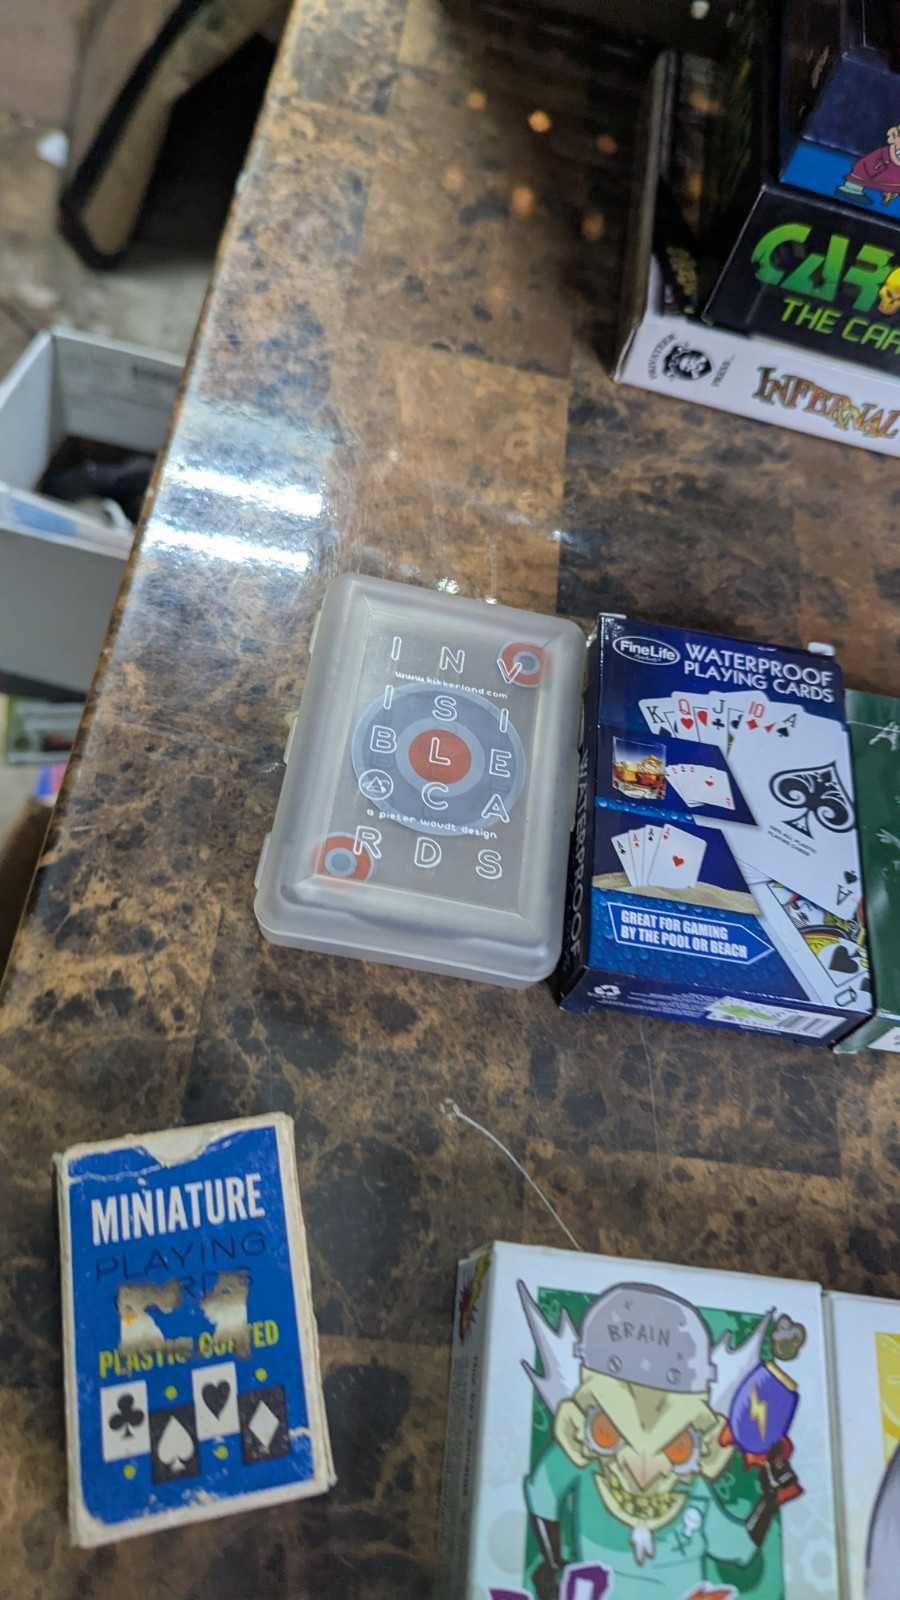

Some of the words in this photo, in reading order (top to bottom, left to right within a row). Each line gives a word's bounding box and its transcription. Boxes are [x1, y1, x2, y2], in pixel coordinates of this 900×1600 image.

[782, 297, 842, 334] THE
[648, 333, 677, 380] PRIVATEER
[620, 640, 676, 661] FineLife
[685, 642, 834, 687] WATERPROOF
[395, 671, 508, 700] www.kikkerland.com
[684, 660, 768, 690] PLAYING
[773, 679, 834, 703] CARDS
[646, 706, 665, 724] K
[677, 699, 692, 716] Q
[712, 699, 726, 714] J
[781, 713, 798, 728] A
[379, 811, 416, 826] pieter
[420, 818, 457, 832] woudt
[461, 824, 498, 840] design
[621, 909, 657, 930] GREAT
[659, 916, 681, 933] FOR
[683, 921, 729, 940] GAMING
[621, 924, 637, 940] BY
[639, 926, 660, 945] THE
[662, 930, 690, 950] POOL
[692, 936, 709, 953] OR
[711, 939, 748, 959] BEACH
[91, 1173, 266, 1246] MINIATURE
[96, 1230, 266, 1284] PLAYING
[198, 1319, 279, 1359] COED
[607, 1321, 670, 1347] BRAIN
